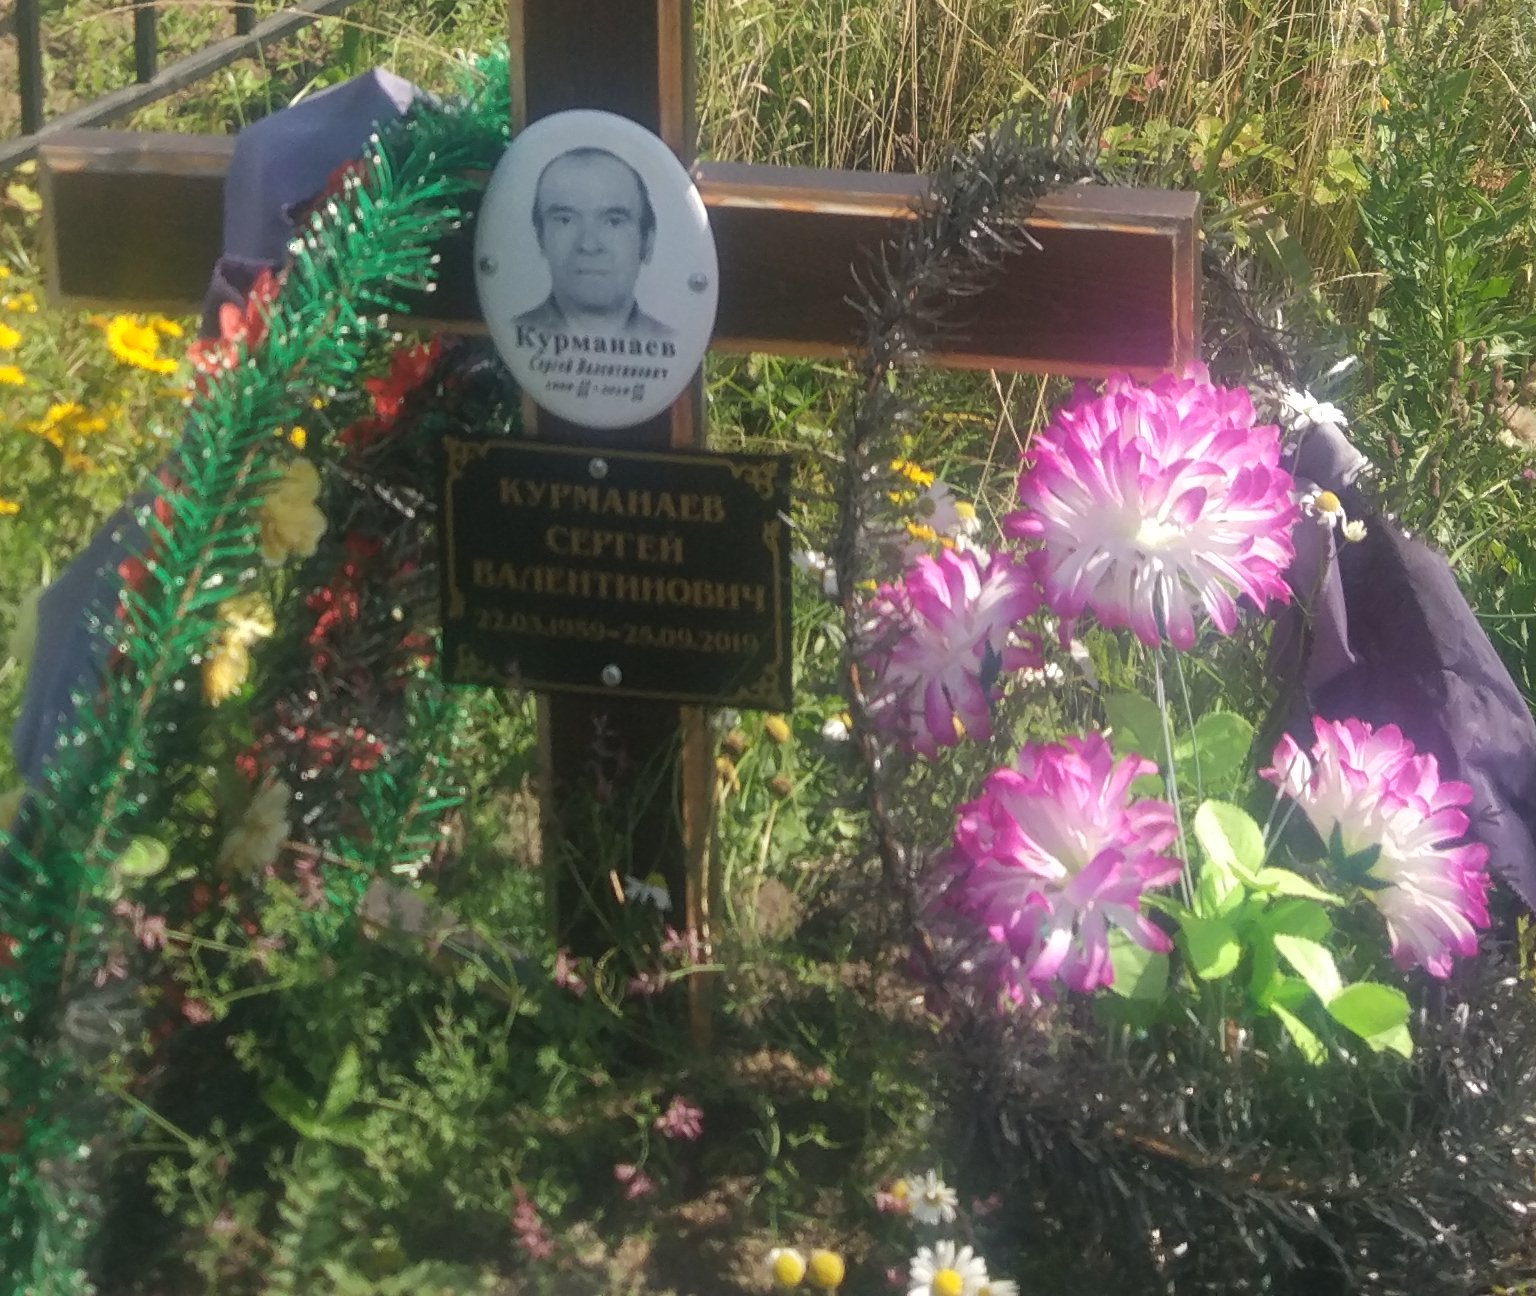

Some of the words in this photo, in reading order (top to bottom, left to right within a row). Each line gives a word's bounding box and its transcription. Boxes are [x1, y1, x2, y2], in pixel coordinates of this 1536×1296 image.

[514, 323, 677, 359] Курманаев
[499, 477, 726, 523] КУРМАНАЕВ
[545, 524, 684, 564] СЕРГЕЙ
[472, 558, 766, 614] ВАЛЕНТИНОВИЧ
